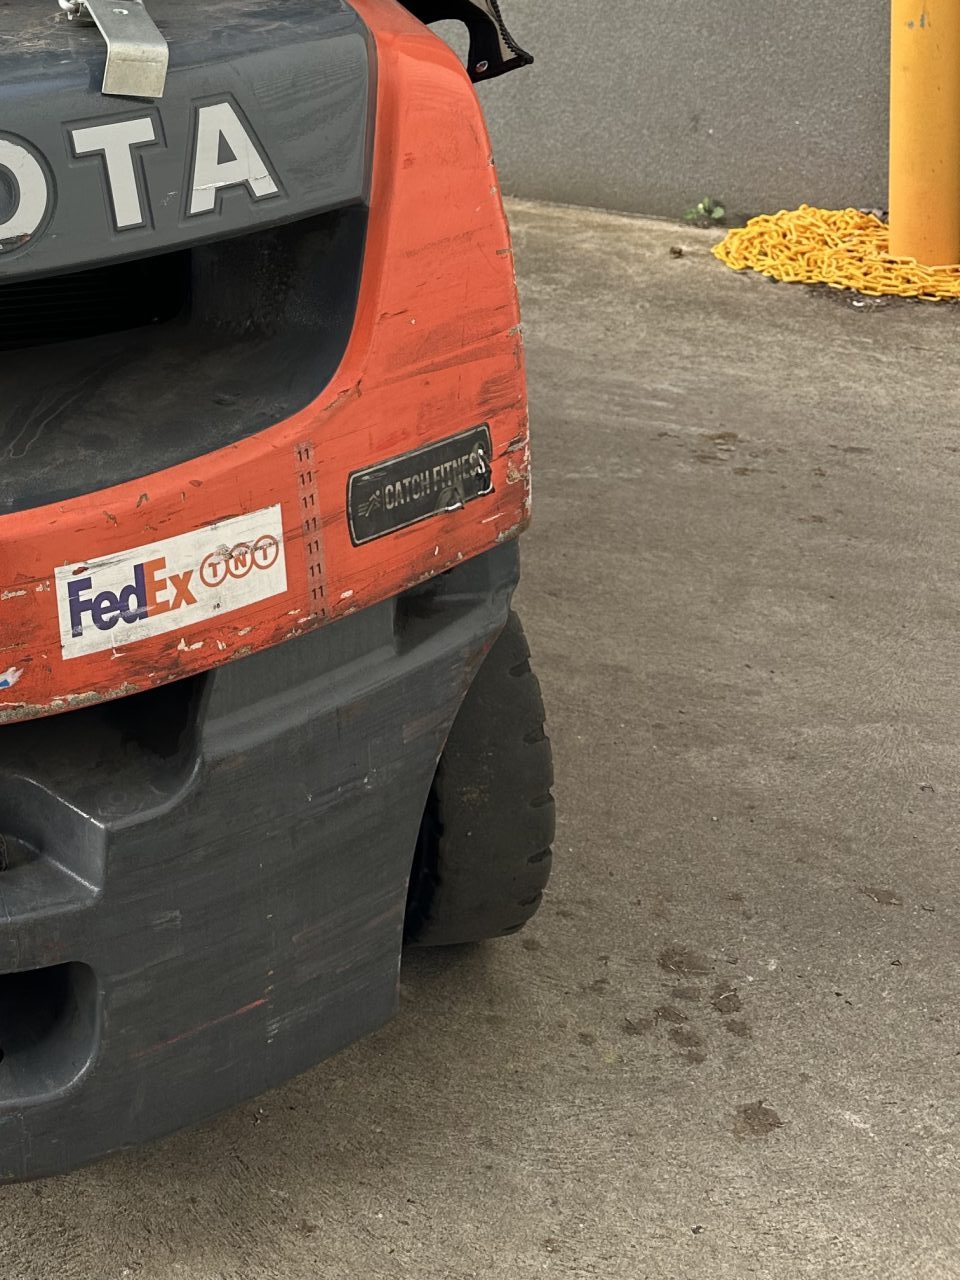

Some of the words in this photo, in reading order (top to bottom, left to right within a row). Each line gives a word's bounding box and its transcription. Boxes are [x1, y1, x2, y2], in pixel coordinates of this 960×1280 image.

[384, 470, 430, 510] CATCH
[432, 449, 486, 491] FITNES
[67, 556, 197, 639] FedEx
